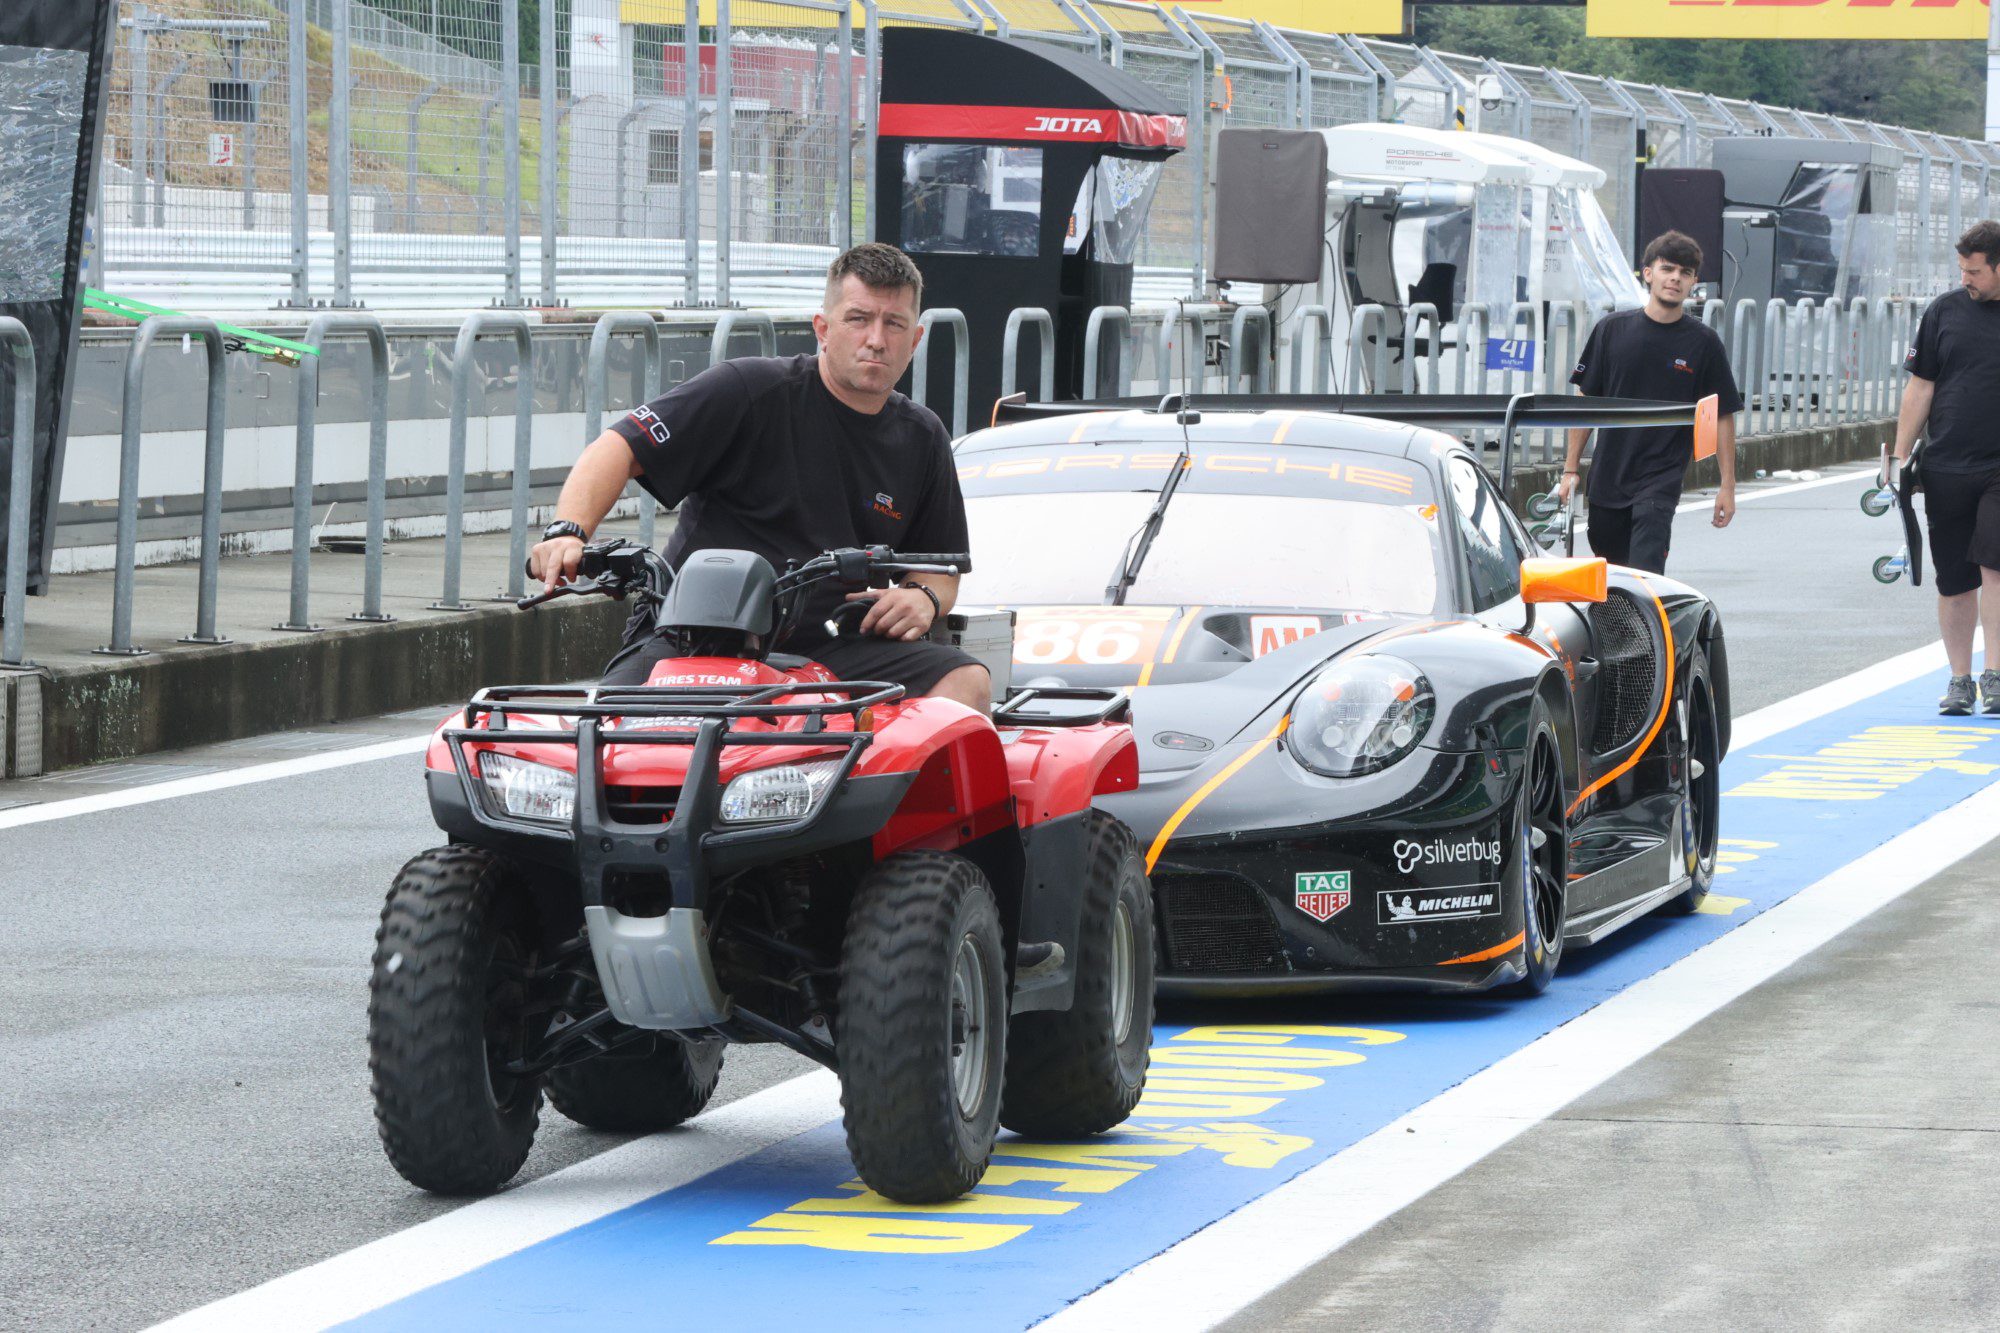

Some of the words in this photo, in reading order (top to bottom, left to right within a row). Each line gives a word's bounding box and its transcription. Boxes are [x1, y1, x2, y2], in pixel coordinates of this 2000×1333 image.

[1025, 117, 1102, 133] JOTA
[1386, 148, 1454, 158] PORSCHE
[1499, 340, 1527, 359] 41
[631, 404, 670, 443] BFG
[1013, 620, 1144, 664] 86
[654, 675, 695, 686] TIRES
[698, 674, 742, 686] TEAM
[1424, 836, 1502, 865] silverbug
[1300, 875, 1347, 891] TAG
[1299, 893, 1347, 918] HEUER
[1418, 893, 1494, 912] MICHELIN
